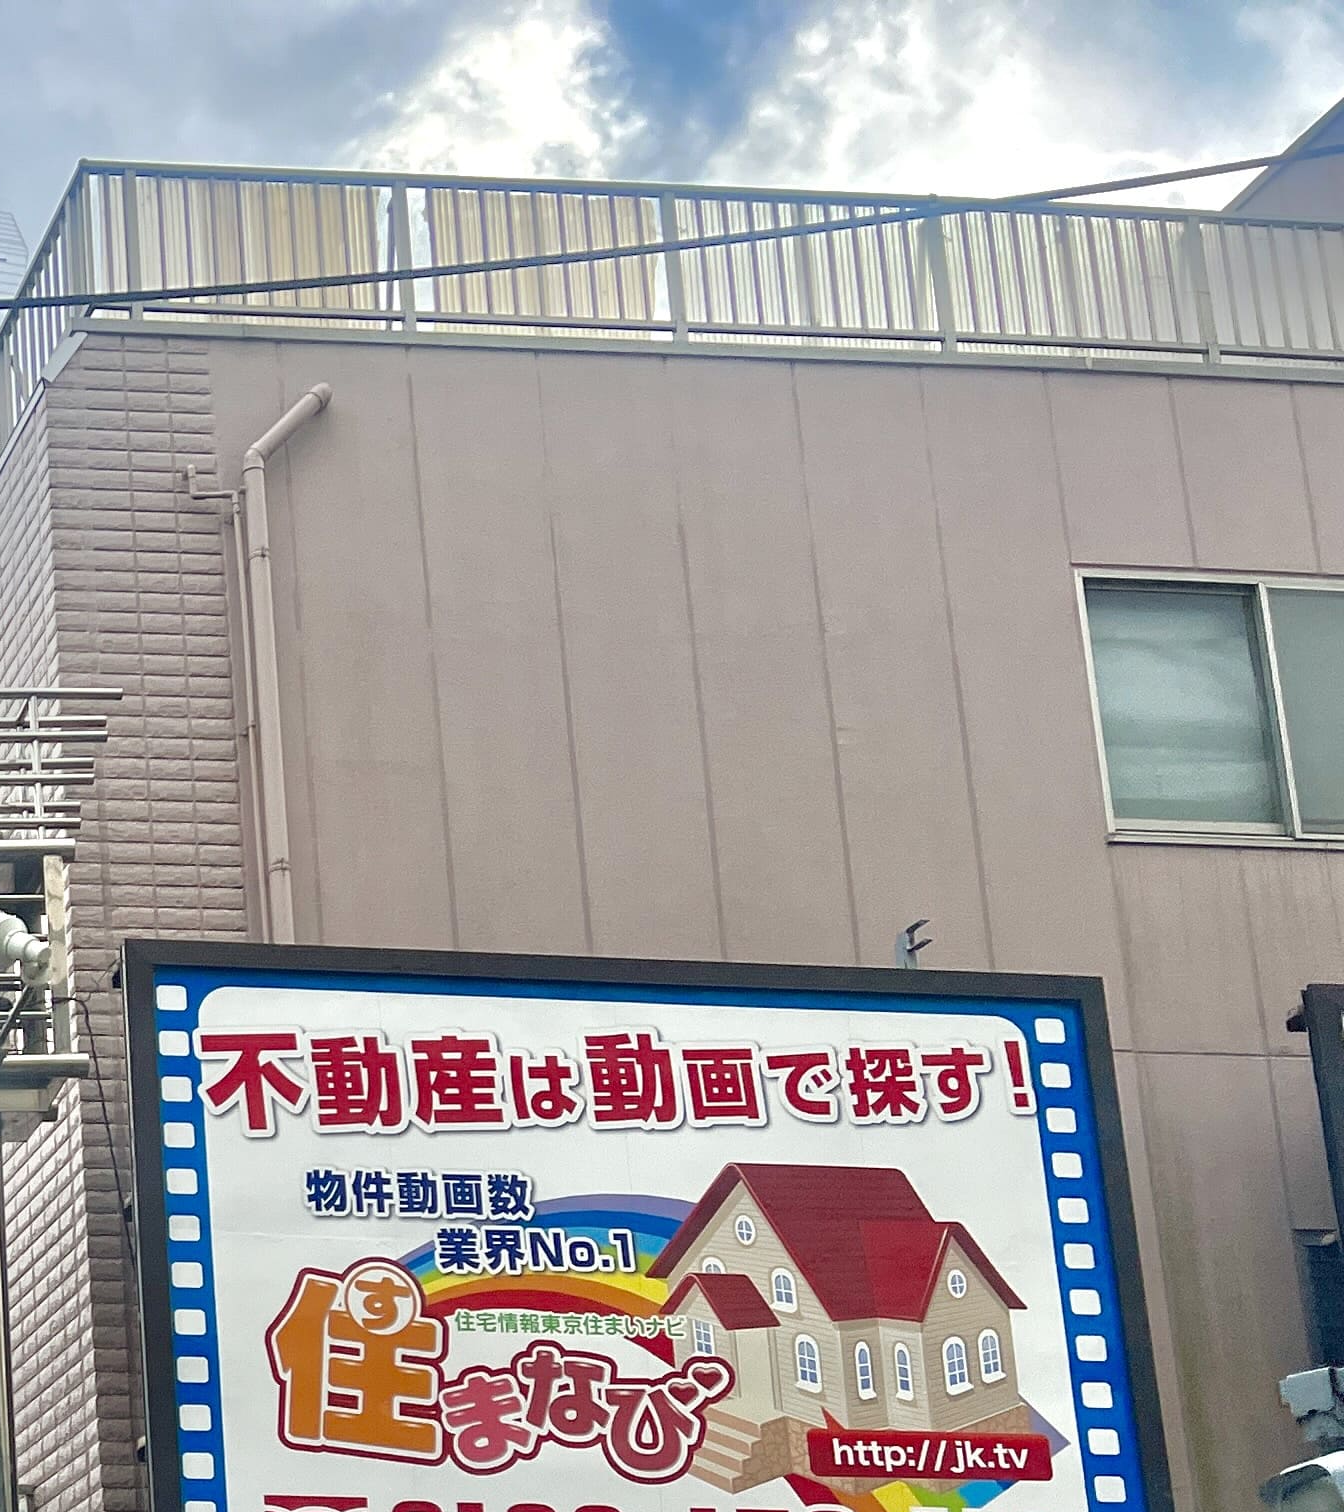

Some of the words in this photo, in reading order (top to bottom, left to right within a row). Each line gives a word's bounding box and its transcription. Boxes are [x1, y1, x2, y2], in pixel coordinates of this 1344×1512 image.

[202, 1030, 1035, 1132] 不動産は動画で探す!
[306, 1170, 534, 1219] 物件動画数
[437, 1229, 635, 1271] 業界No.1
[455, 1311, 685, 1338] 住宅情報東京住まいナビ
[831, 1437, 1030, 1474] http://jk.tv
